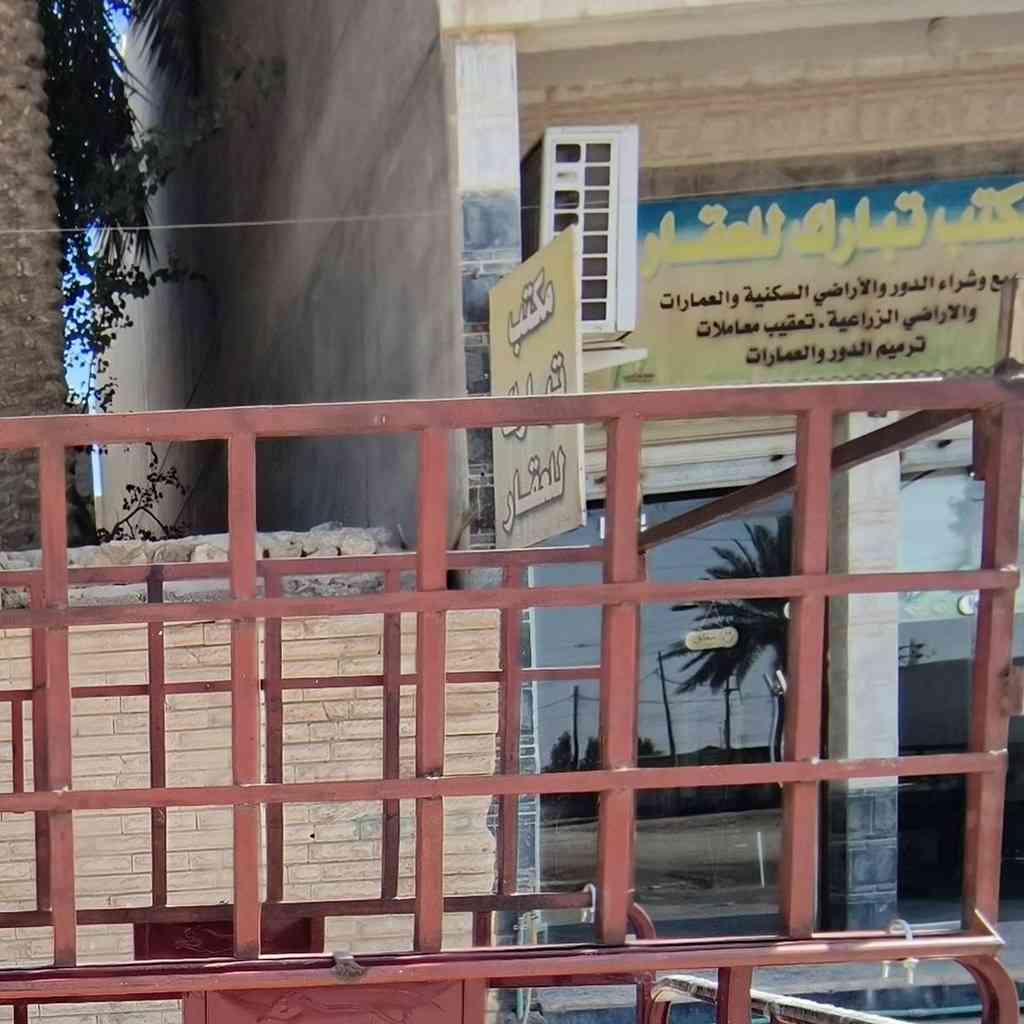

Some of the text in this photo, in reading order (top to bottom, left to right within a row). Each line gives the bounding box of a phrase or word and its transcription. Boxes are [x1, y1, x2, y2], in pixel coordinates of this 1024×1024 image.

[640, 182, 1024, 283] كتب تبارك للعقار
[889, 274, 935, 297] الدور
[938, 269, 986, 293] وشراء
[659, 290, 740, 312] والعمارات
[744, 284, 810, 308] السكنية
[507, 267, 555, 358] مكتب
[696, 320, 760, 338] معاملات
[763, 313, 816, 337] تعقيب
[745, 336, 926, 367] ترميم الدور والعمارات
[503, 445, 566, 535] للعقار
